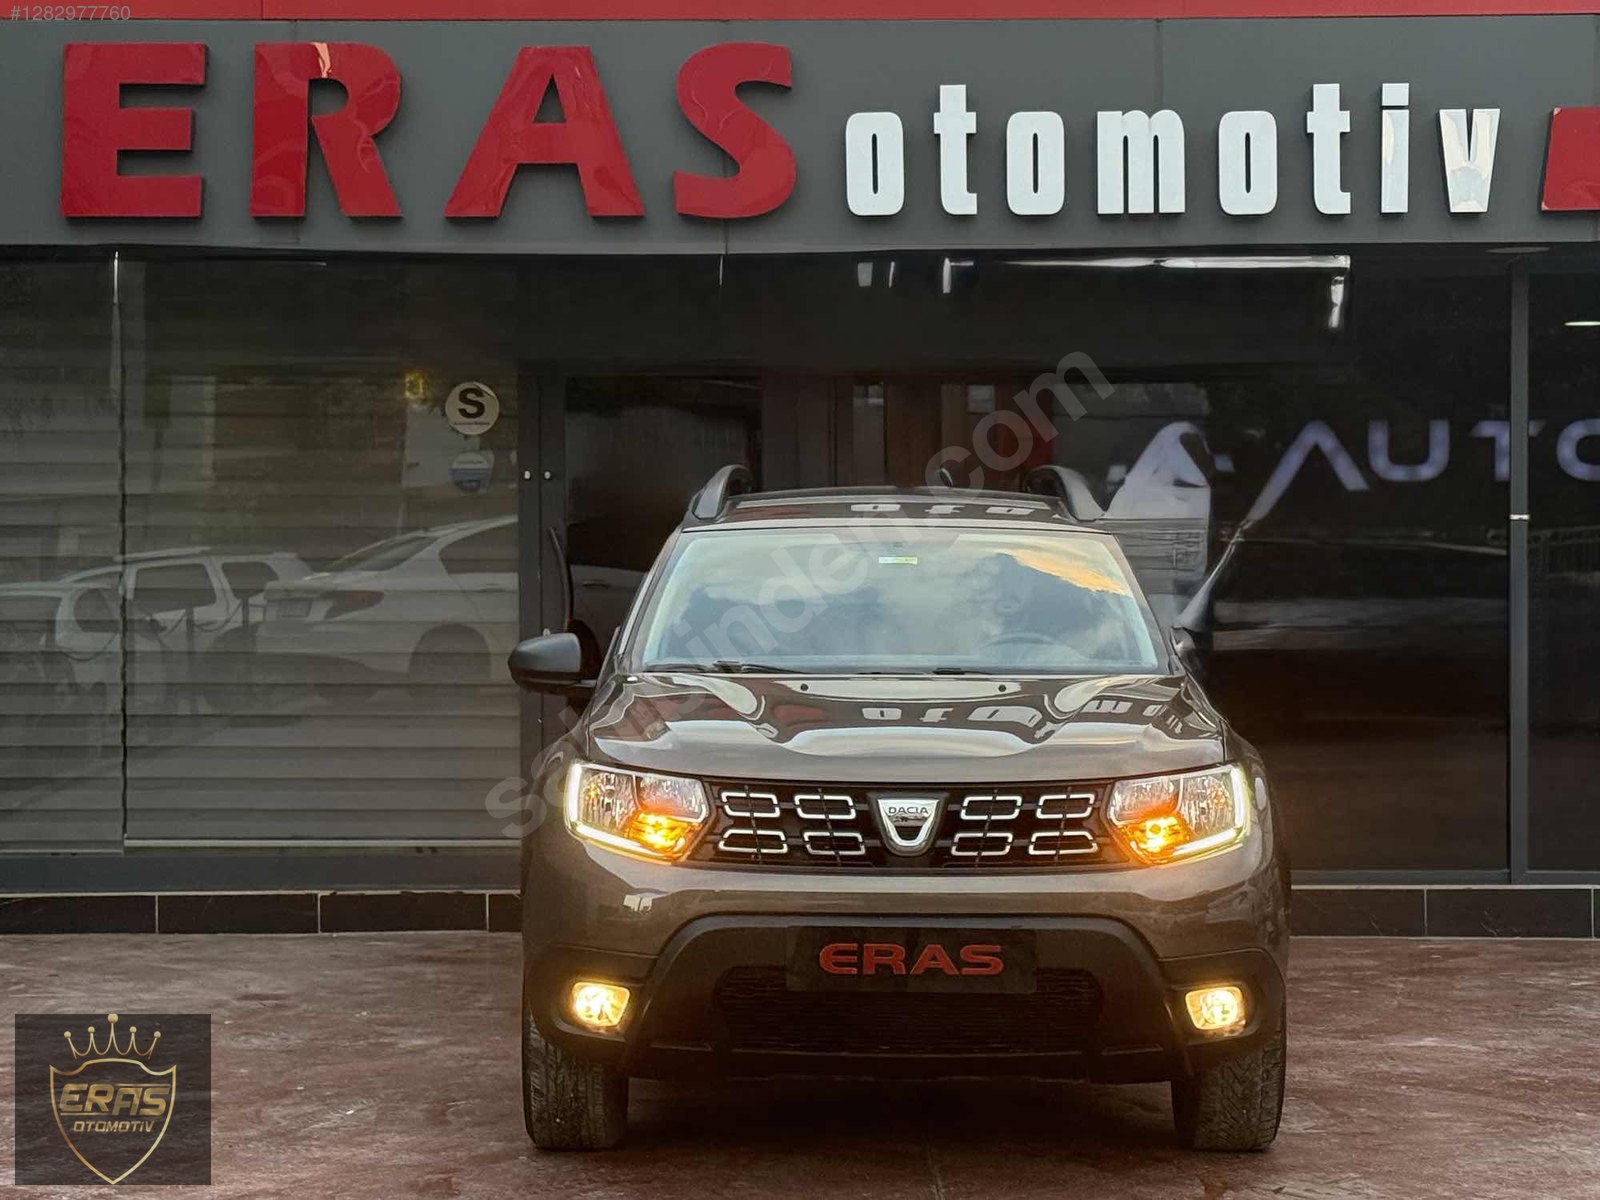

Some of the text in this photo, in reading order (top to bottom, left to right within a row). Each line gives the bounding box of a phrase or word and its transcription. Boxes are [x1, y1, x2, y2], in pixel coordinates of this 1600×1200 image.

[60, 41, 1501, 219] ERAS otomotiv
[458, 387, 486, 419] S
[887, 805, 930, 815] DACIA
[819, 943, 1005, 976] ERAS
